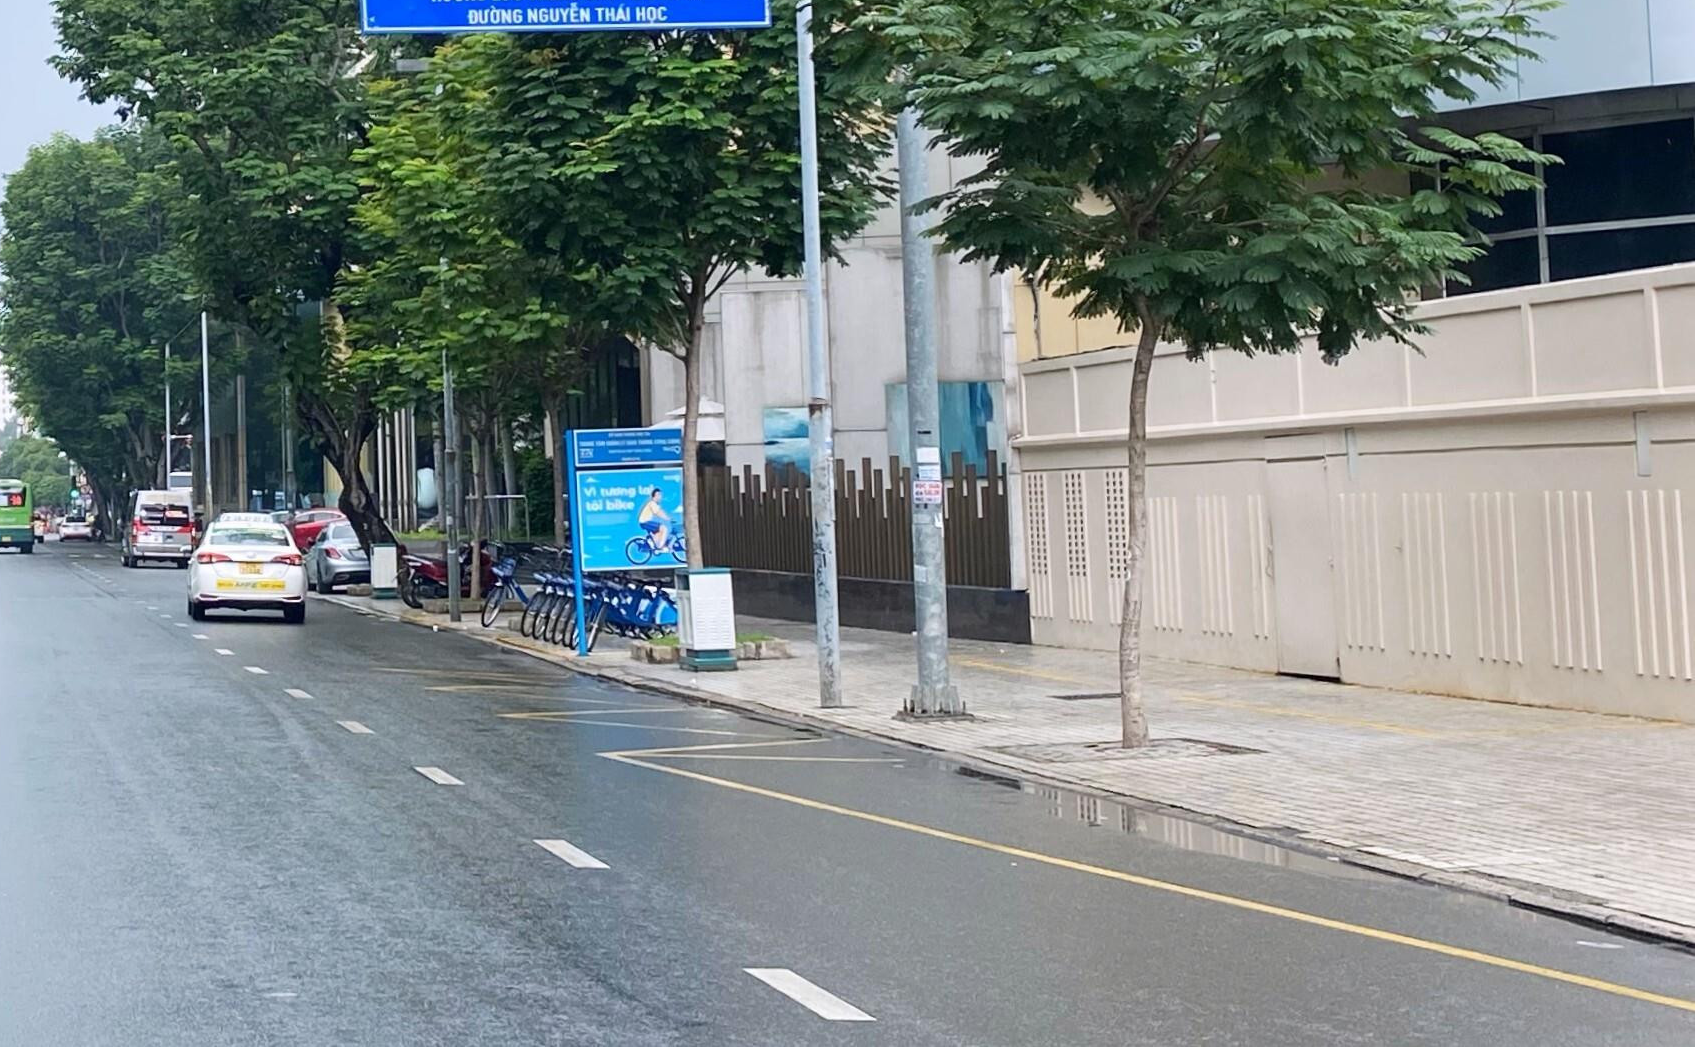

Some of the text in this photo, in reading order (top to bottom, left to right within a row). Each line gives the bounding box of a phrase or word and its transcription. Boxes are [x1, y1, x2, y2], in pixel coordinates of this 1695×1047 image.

[467, 2, 668, 25] ĐƯỜNG NGUYỄN THÁI HỌC
